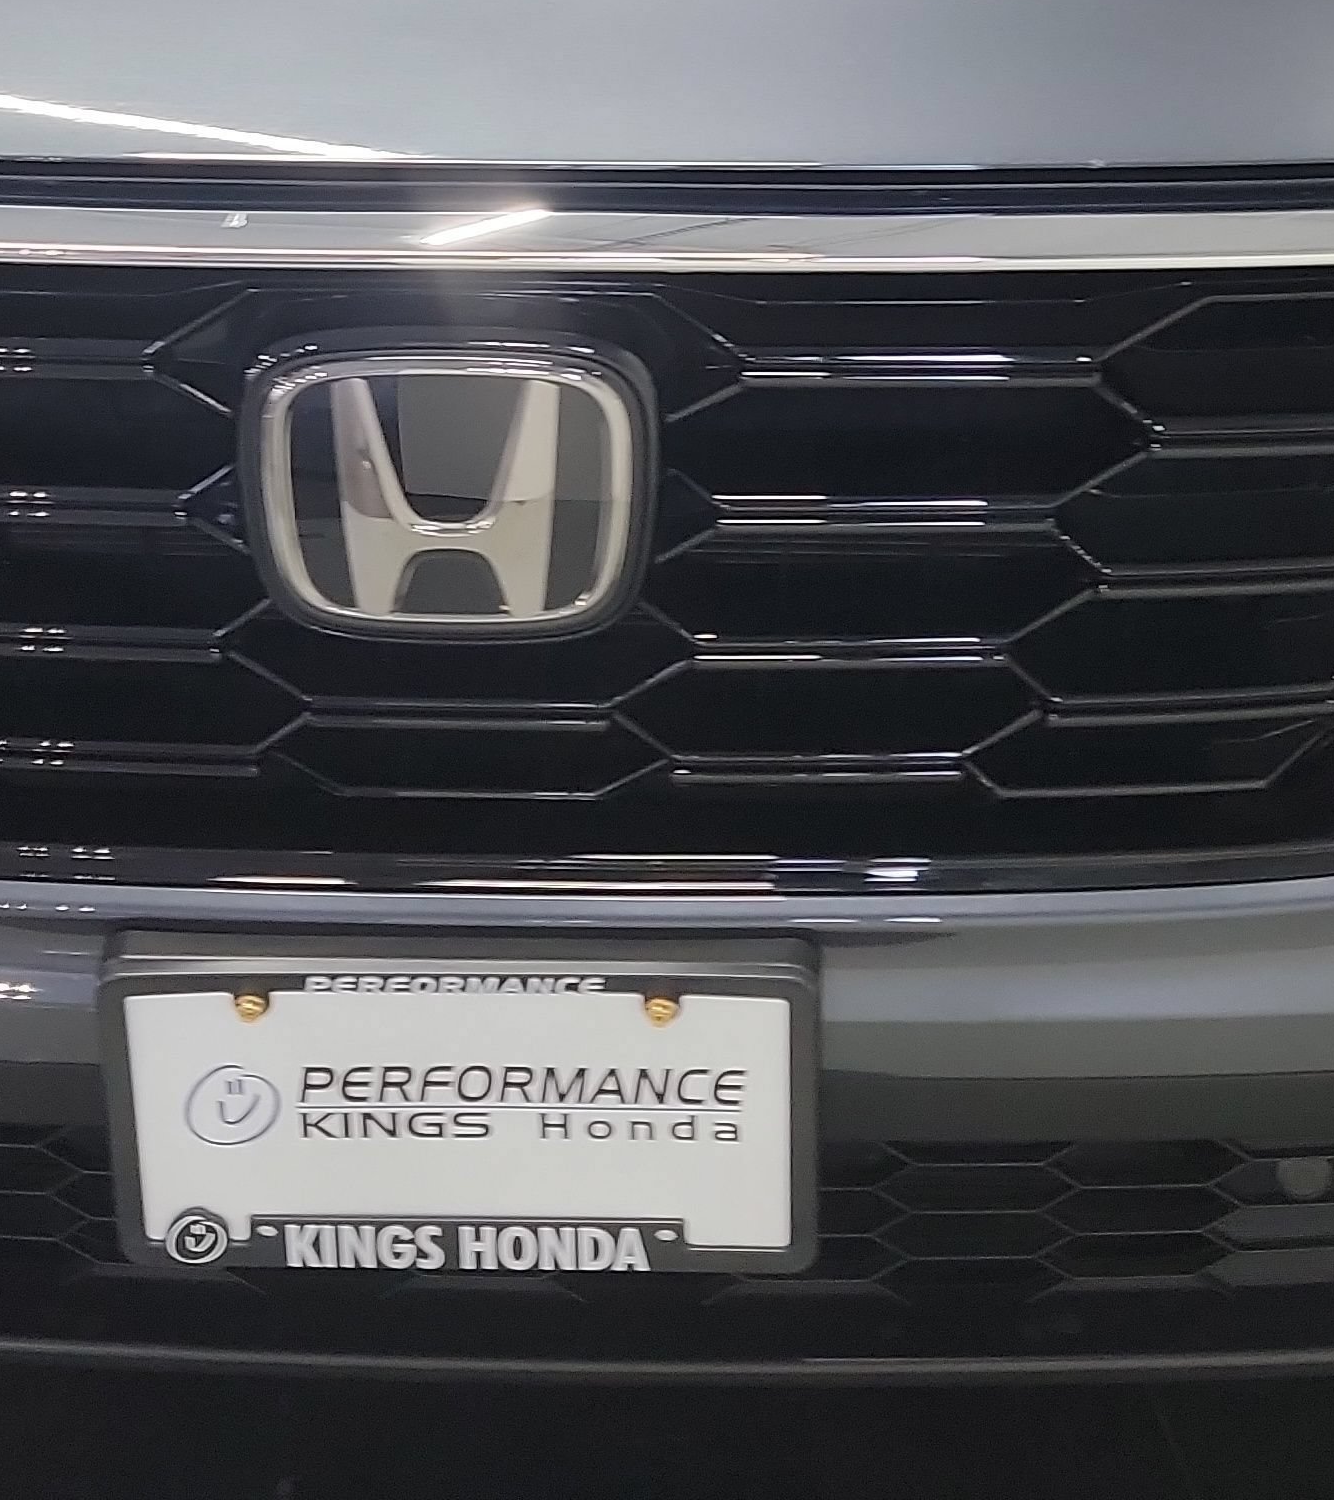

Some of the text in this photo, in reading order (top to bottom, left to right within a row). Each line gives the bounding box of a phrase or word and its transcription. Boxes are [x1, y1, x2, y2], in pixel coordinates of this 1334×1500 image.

[304, 975, 606, 994] PERFORMANCE
[299, 1065, 748, 1104] PERFORMANCE
[300, 1111, 740, 1141] KINGS Honda
[283, 1224, 652, 1272] KINGS HONDA
